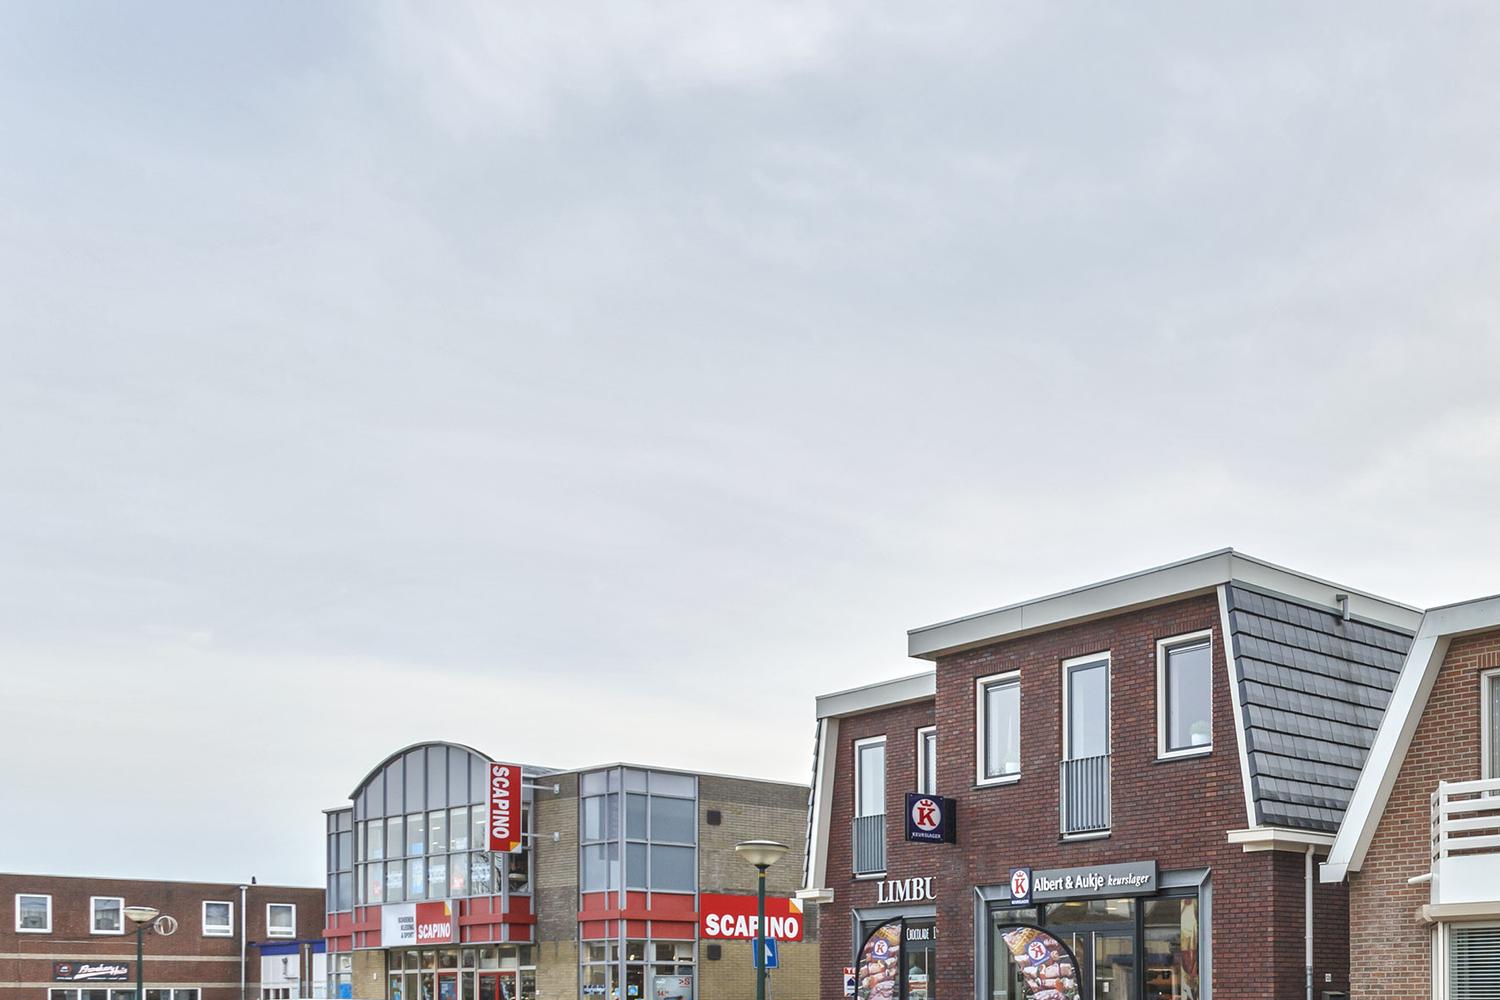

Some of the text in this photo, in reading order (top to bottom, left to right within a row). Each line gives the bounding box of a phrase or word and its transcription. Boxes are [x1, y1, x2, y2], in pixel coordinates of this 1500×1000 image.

[492, 765, 510, 839] SCAPINO
[917, 807, 936, 826] K
[1033, 872, 1150, 892] Albert & Aukje keurslager
[418, 922, 451, 940] SCAPINO
[705, 913, 799, 938] SCAPINO
